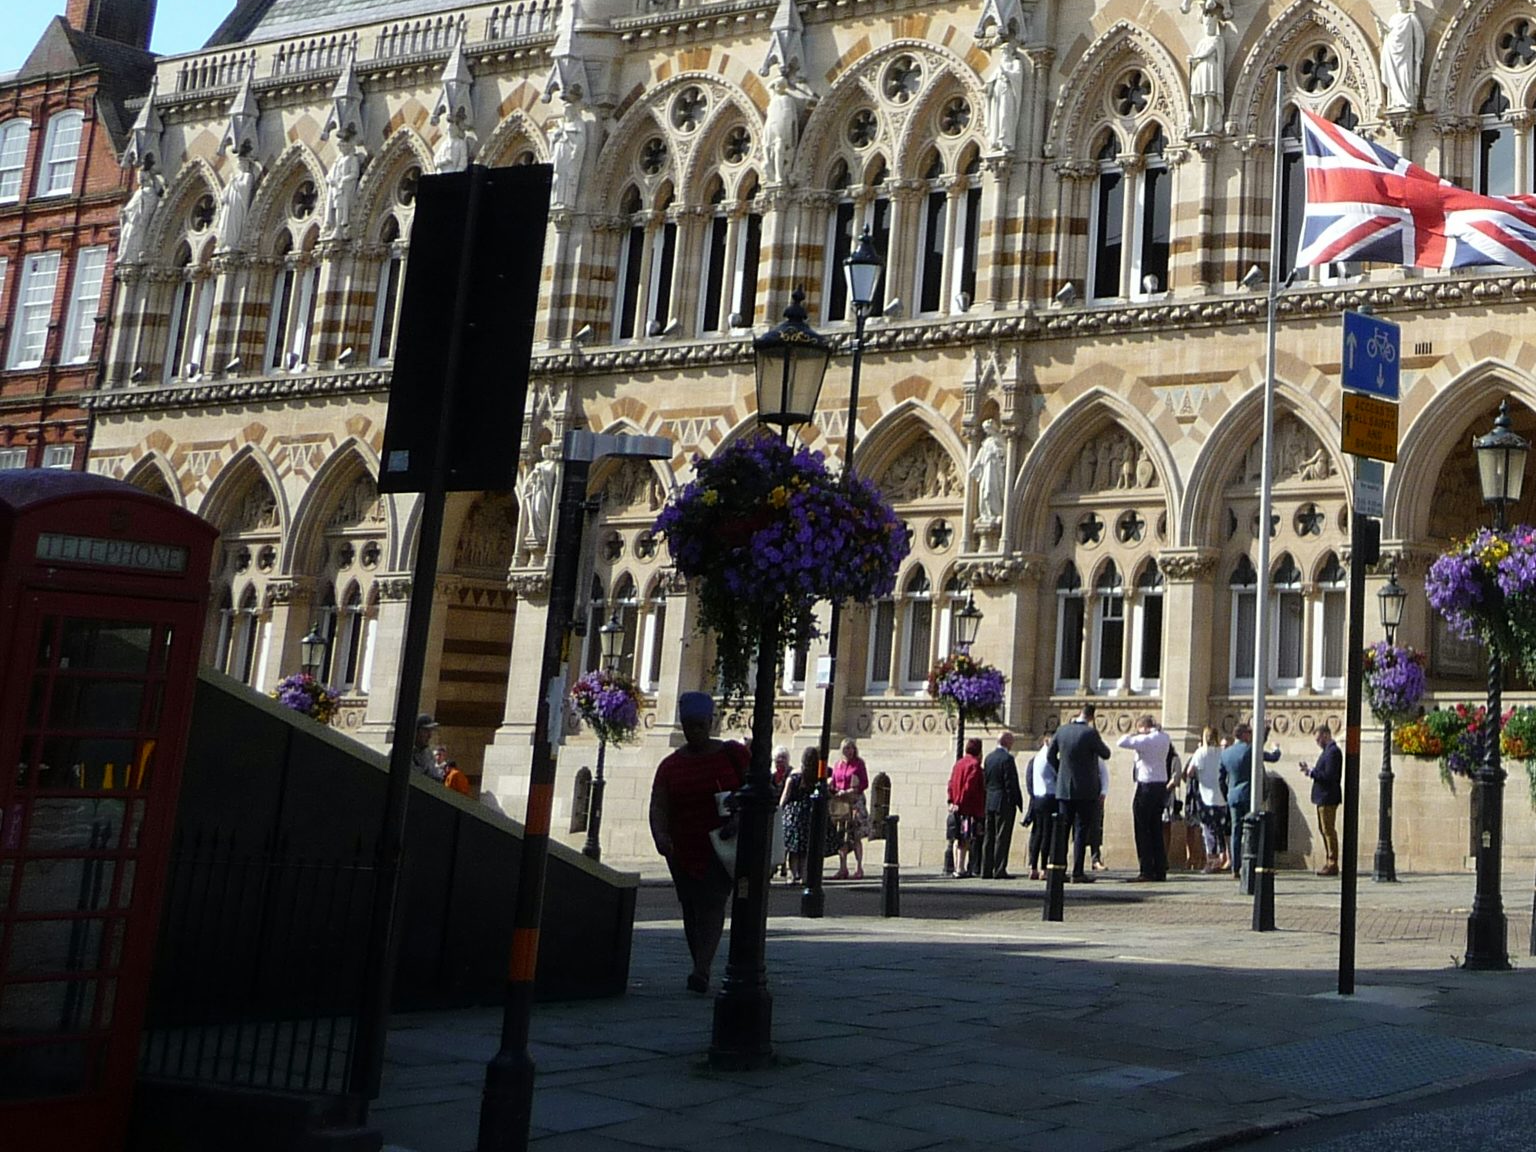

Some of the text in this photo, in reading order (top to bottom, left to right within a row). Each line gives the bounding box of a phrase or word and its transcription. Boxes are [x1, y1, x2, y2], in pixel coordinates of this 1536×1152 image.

[1355, 399, 1396, 419] ACCESS TO
[1354, 413, 1395, 430] ALL SAINTS
[1367, 428, 1382, 441] AND
[1355, 438, 1382, 453] BRIDGE
[46, 536, 180, 568] TELEPHONE
